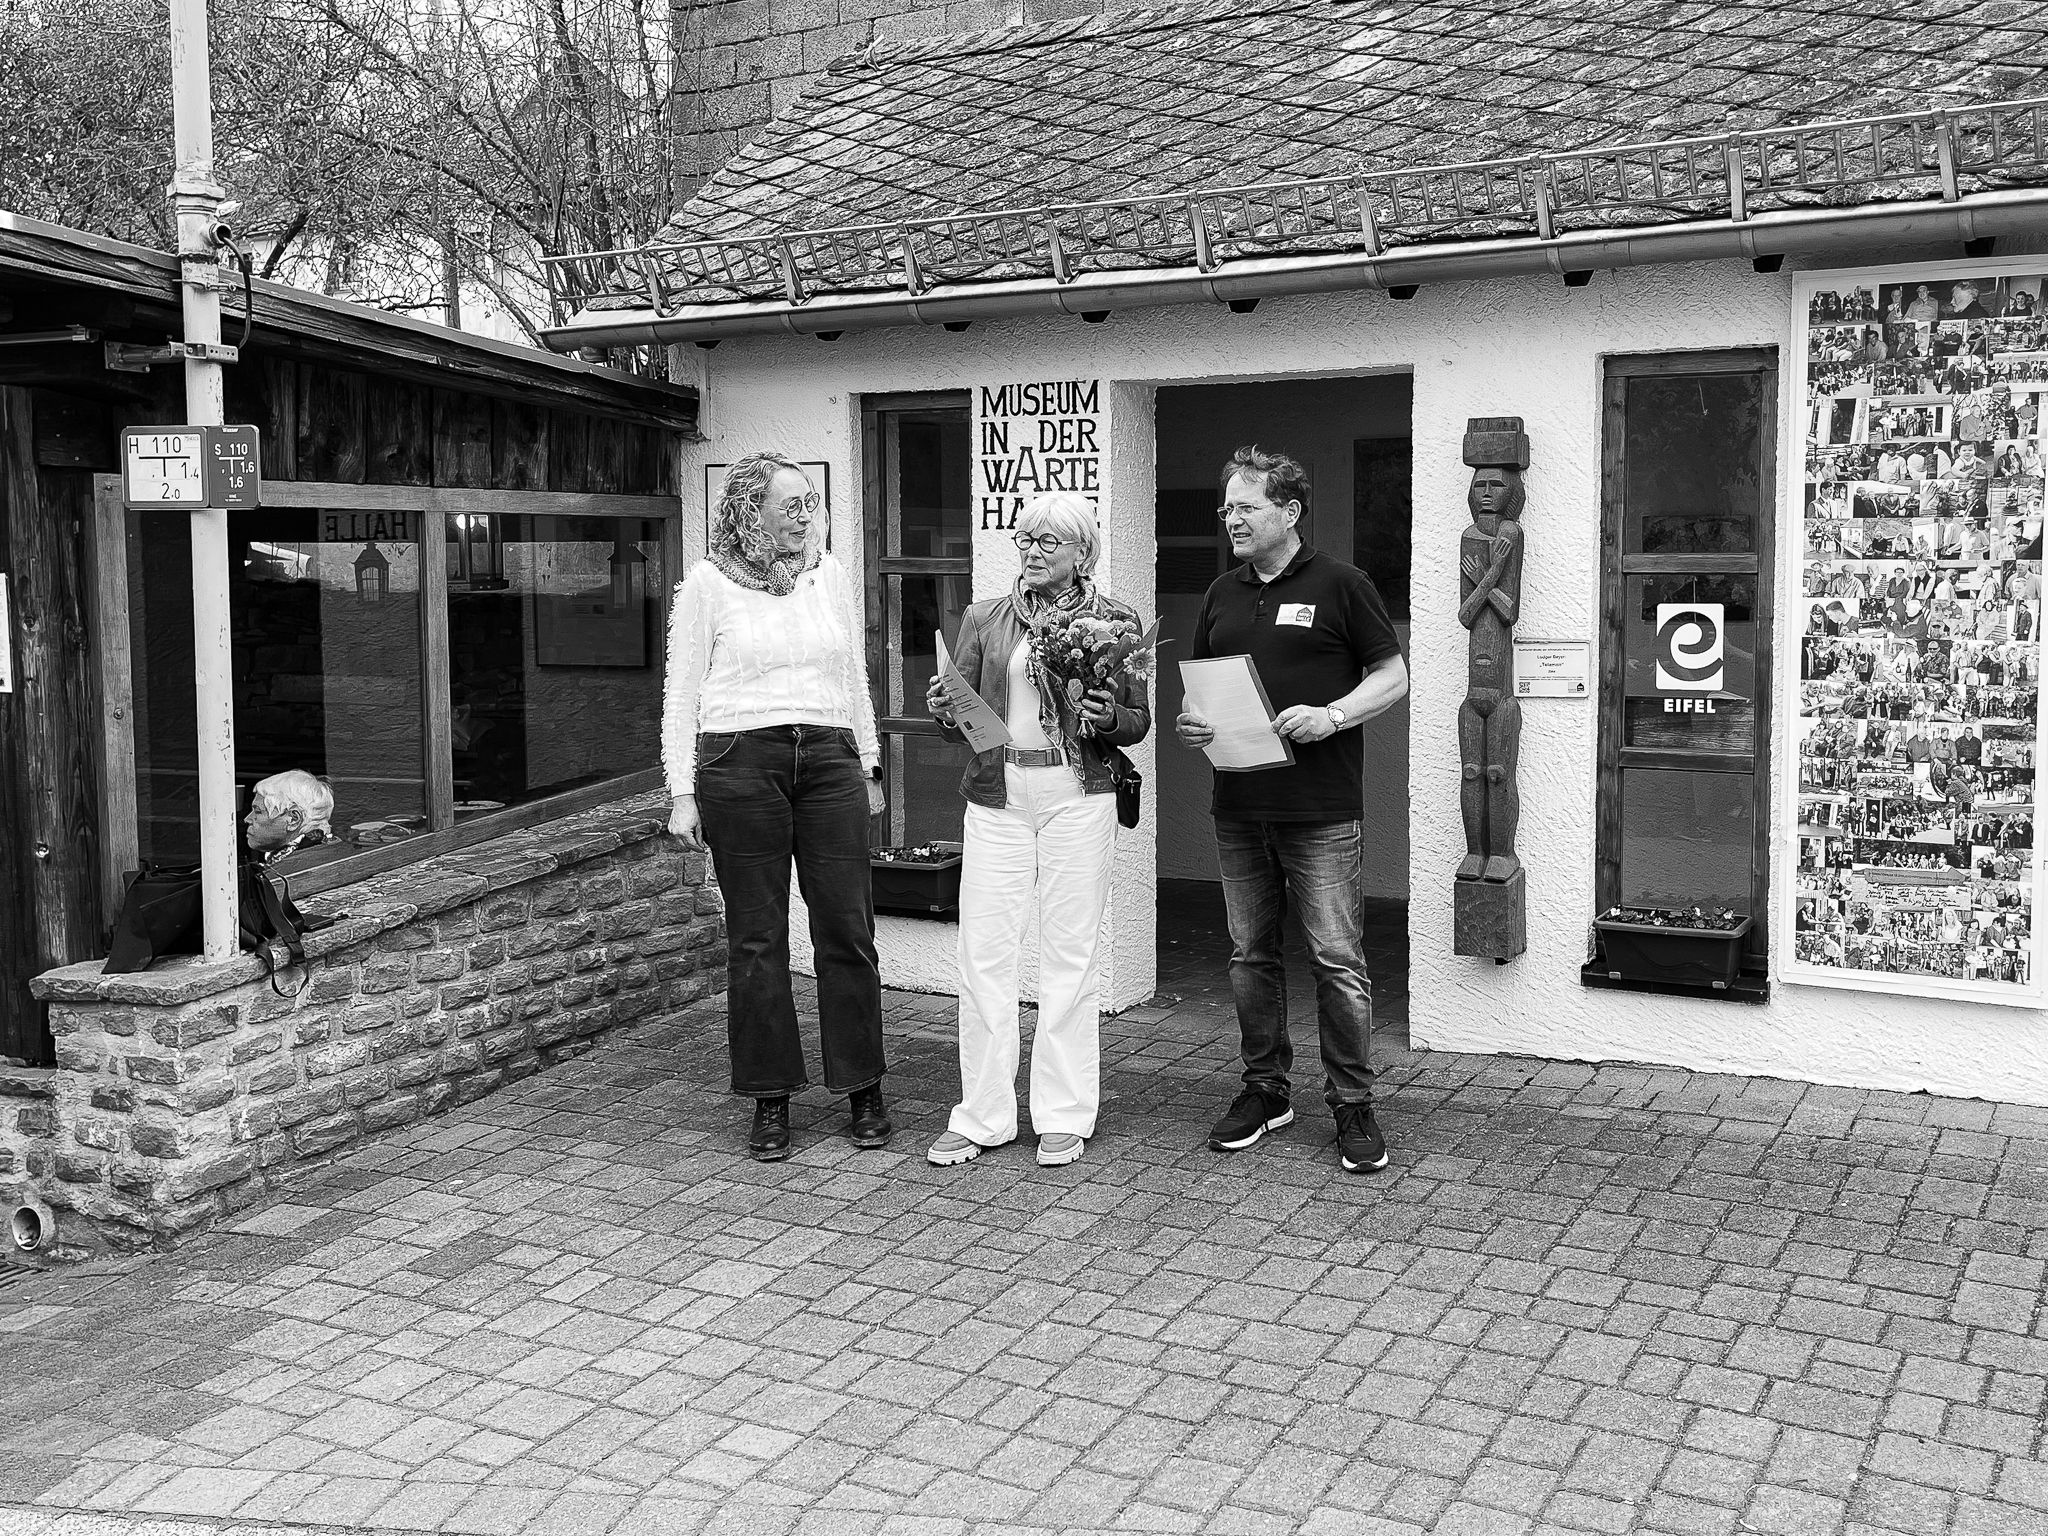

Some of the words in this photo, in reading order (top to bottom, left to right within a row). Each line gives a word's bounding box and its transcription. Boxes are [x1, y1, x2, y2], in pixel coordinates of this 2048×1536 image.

[980, 379, 1100, 418] MUSEUM
[129, 437, 139, 454] H
[152, 436, 182, 454] 110
[981, 421, 1009, 455] IN
[1038, 419, 1100, 453] DER
[214, 443, 222, 456] S
[229, 443, 248, 456] 110
[240, 461, 255, 474] 1,6
[981, 446, 1100, 493] WARTE
[229, 476, 244, 489] 1,6
[1663, 698, 1717, 714] EIFEL
